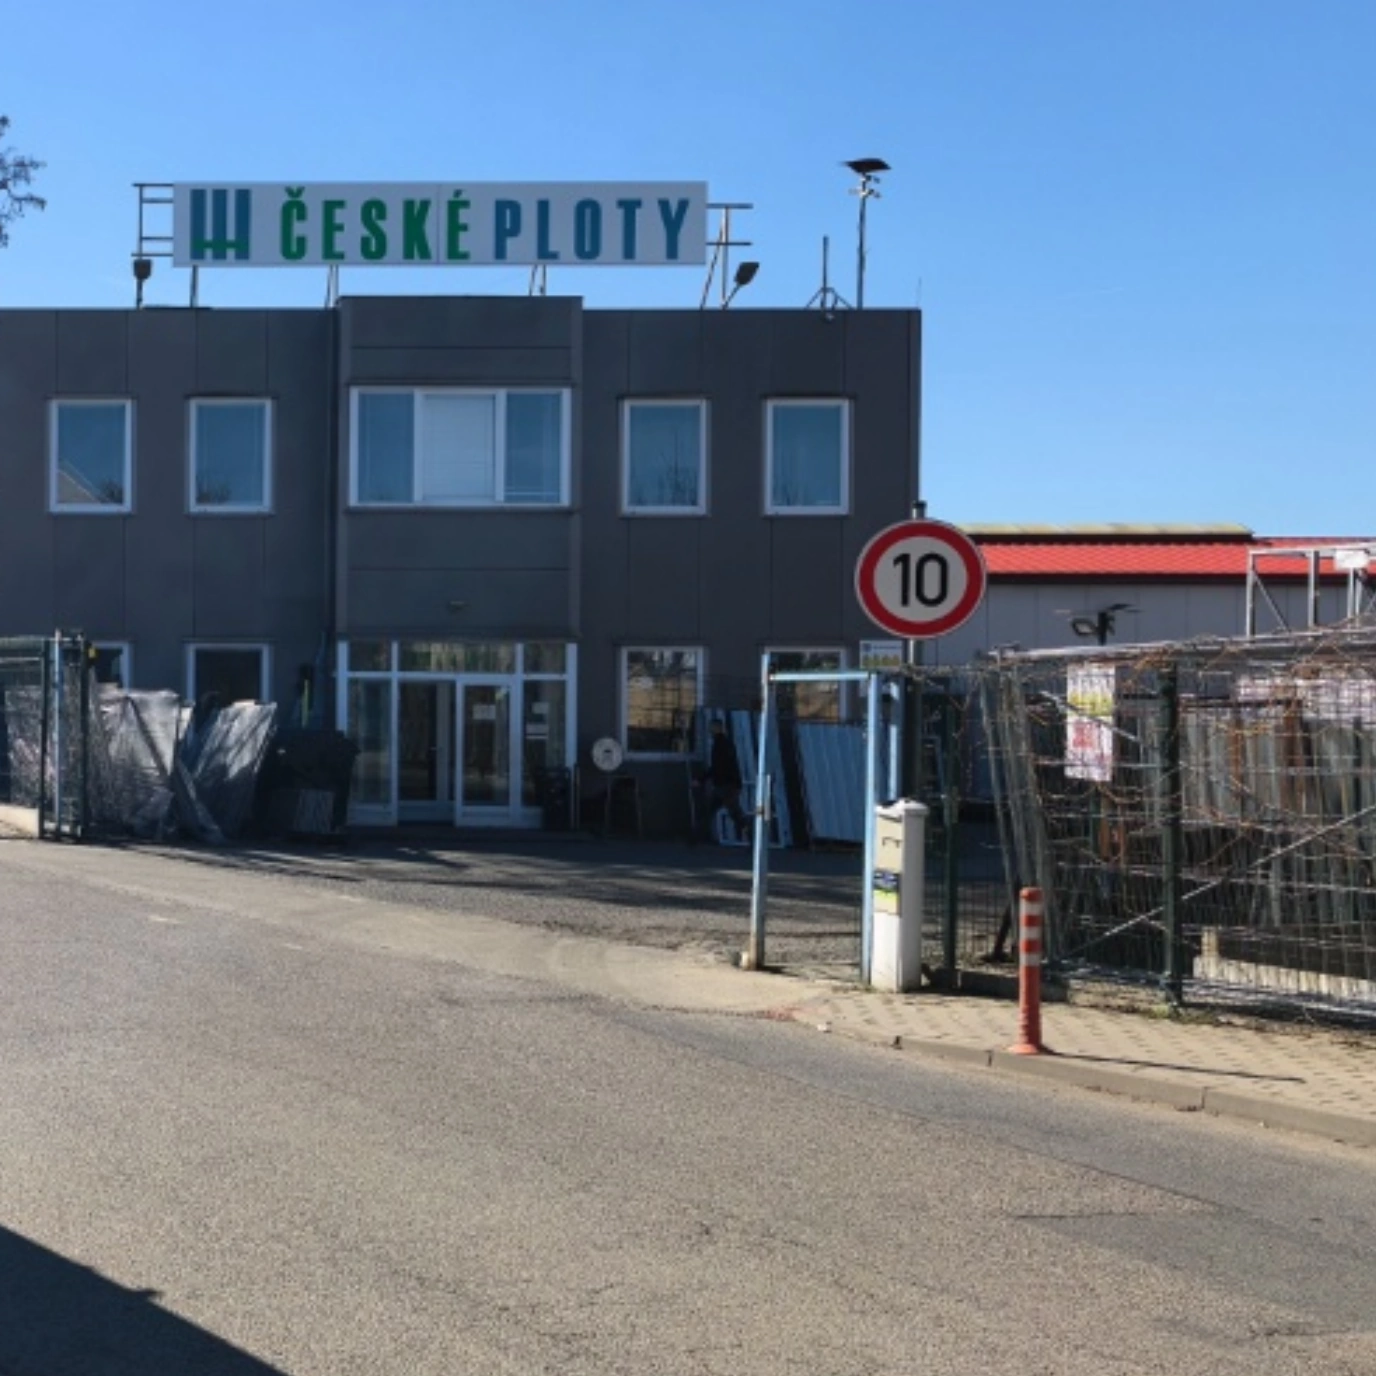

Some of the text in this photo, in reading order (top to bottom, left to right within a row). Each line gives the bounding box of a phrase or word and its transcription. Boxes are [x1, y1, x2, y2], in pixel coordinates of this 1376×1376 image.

[280, 186, 691, 261] ČESKÉ PLOTY
[892, 552, 949, 608] 10
